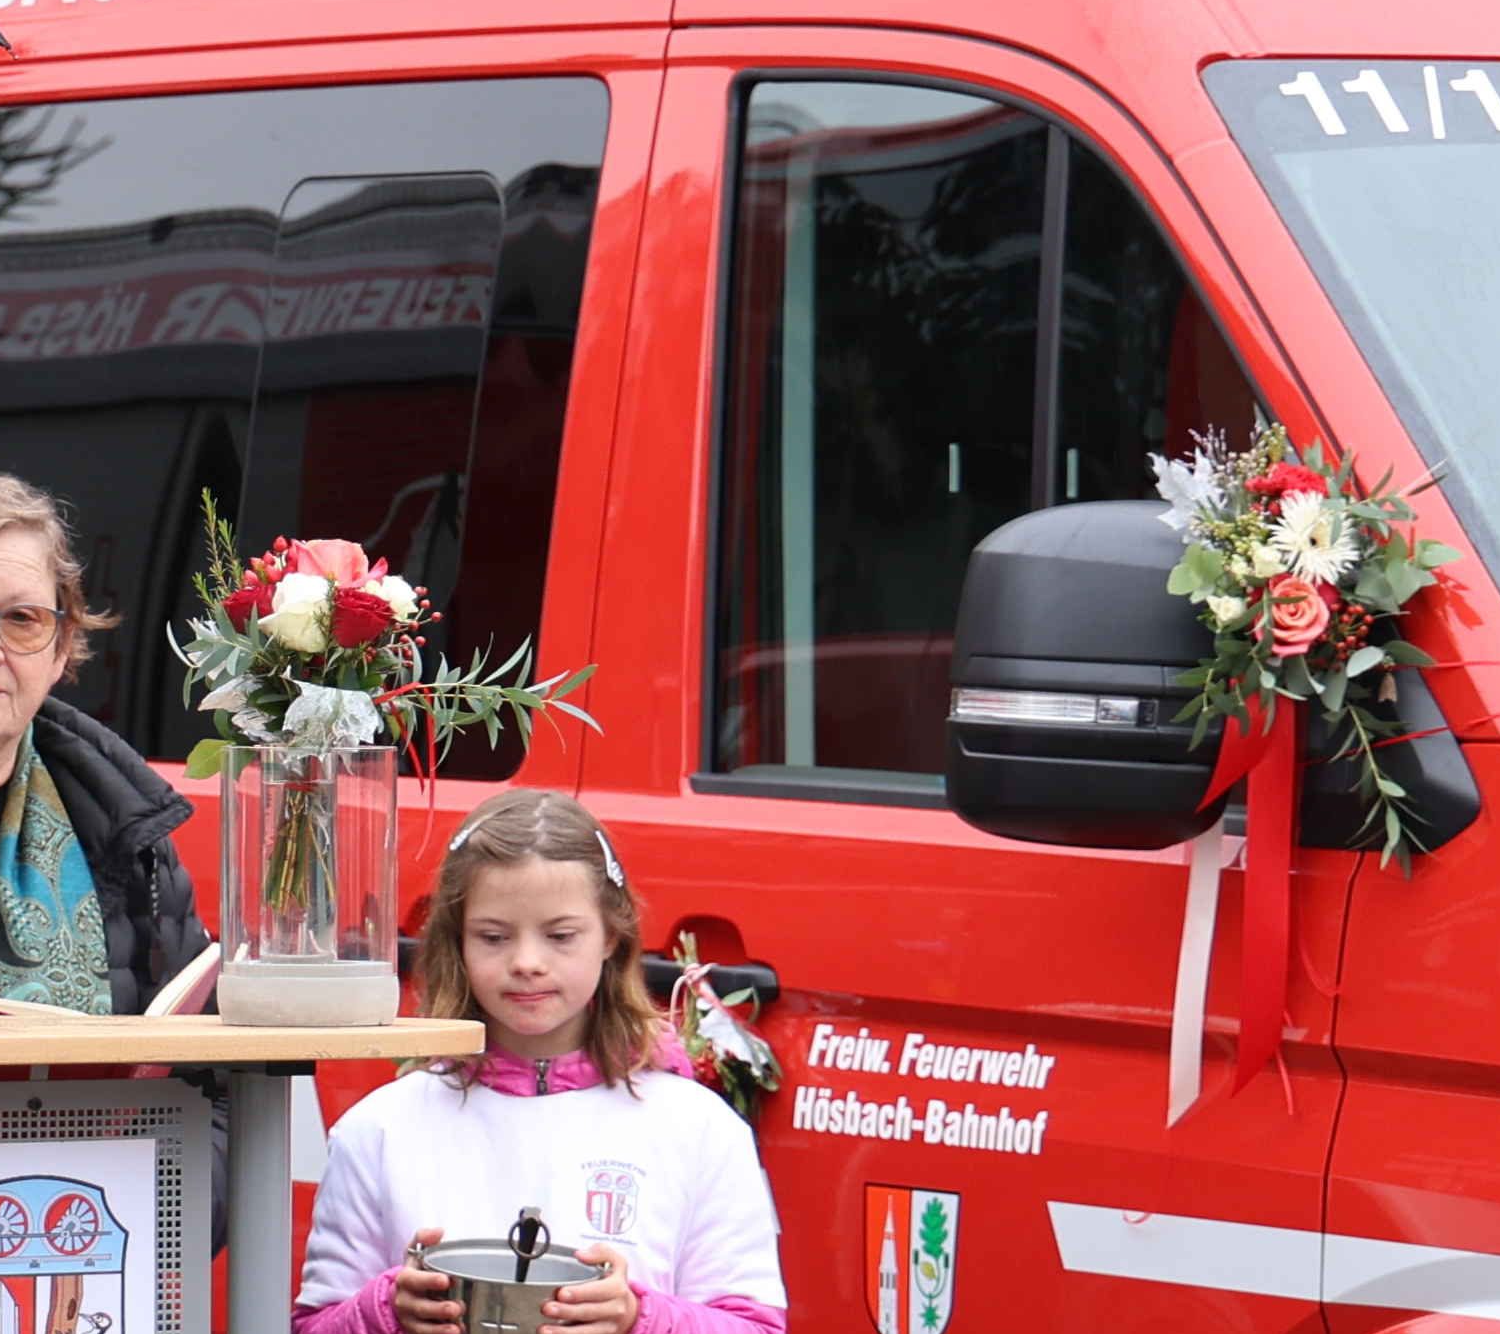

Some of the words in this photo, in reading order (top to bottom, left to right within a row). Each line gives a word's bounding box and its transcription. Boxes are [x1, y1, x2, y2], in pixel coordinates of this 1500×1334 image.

[808, 1024, 890, 1074] Freiw.
[899, 1033, 1055, 1089] Feuerwehr
[793, 1085, 1047, 1156] Hösbach-Bahnhof
